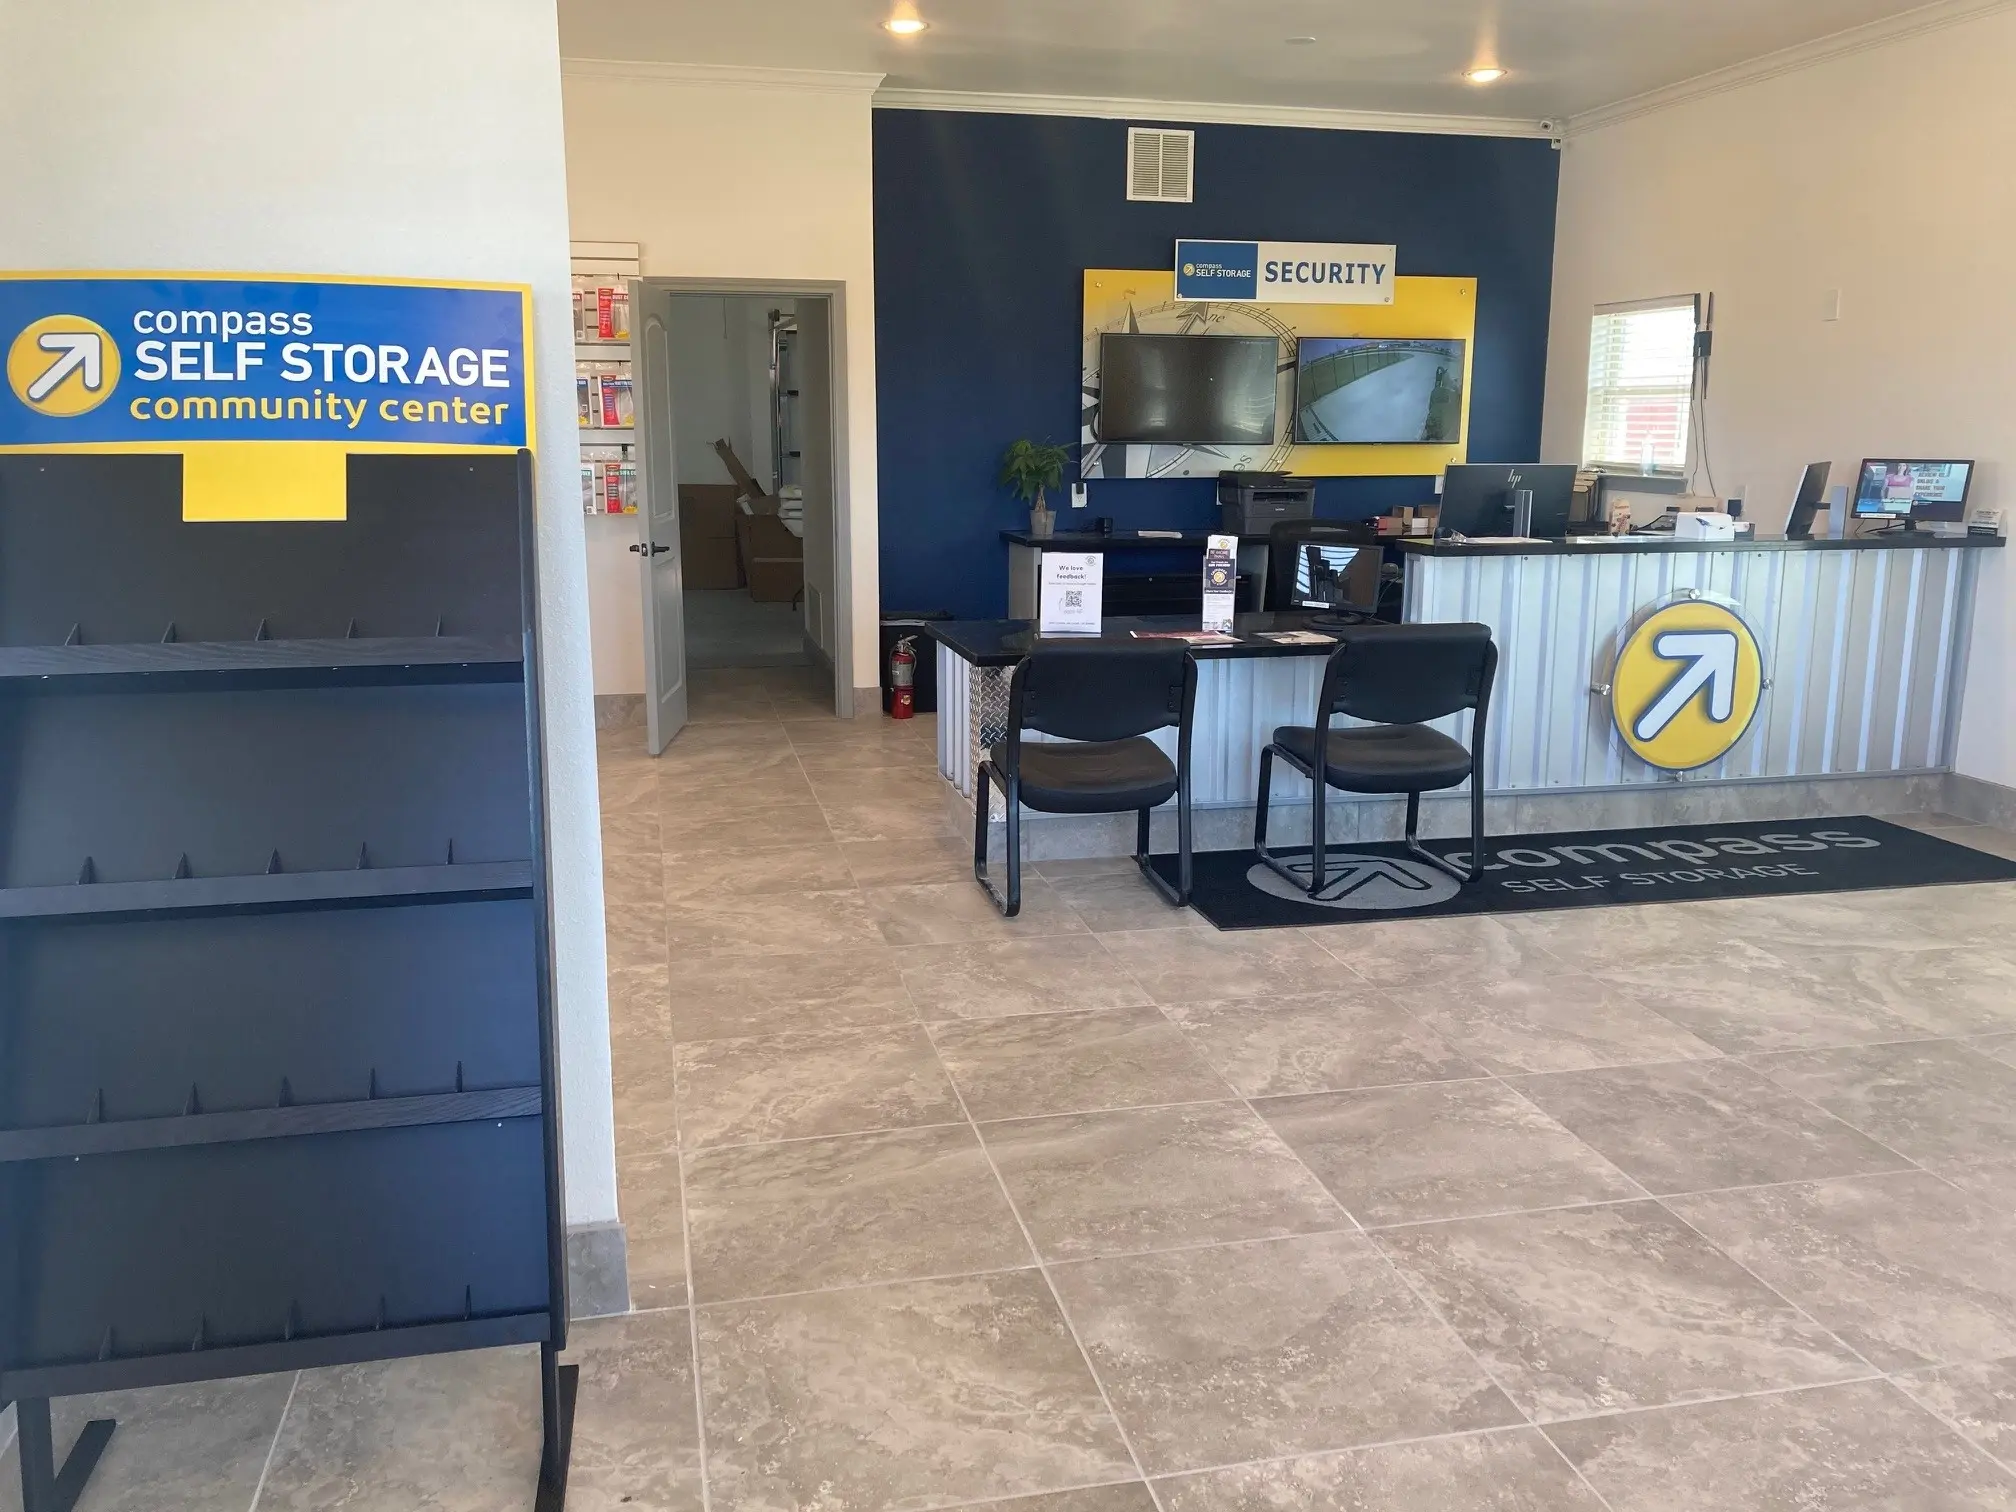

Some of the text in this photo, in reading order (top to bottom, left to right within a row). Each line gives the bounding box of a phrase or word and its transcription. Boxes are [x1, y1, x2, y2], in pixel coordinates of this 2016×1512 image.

[1196, 268, 1251, 278] SELF STORAGE
[1264, 260, 1387, 285] SECURITY
[133, 308, 313, 343] compass
[1206, 311, 1226, 323] ne
[133, 340, 510, 388] SELF STORAGE
[130, 388, 509, 430] community center
[1507, 468, 1522, 489] hp
[1443, 829, 1881, 871] compass
[1500, 863, 1820, 894] SELF STORAGE
